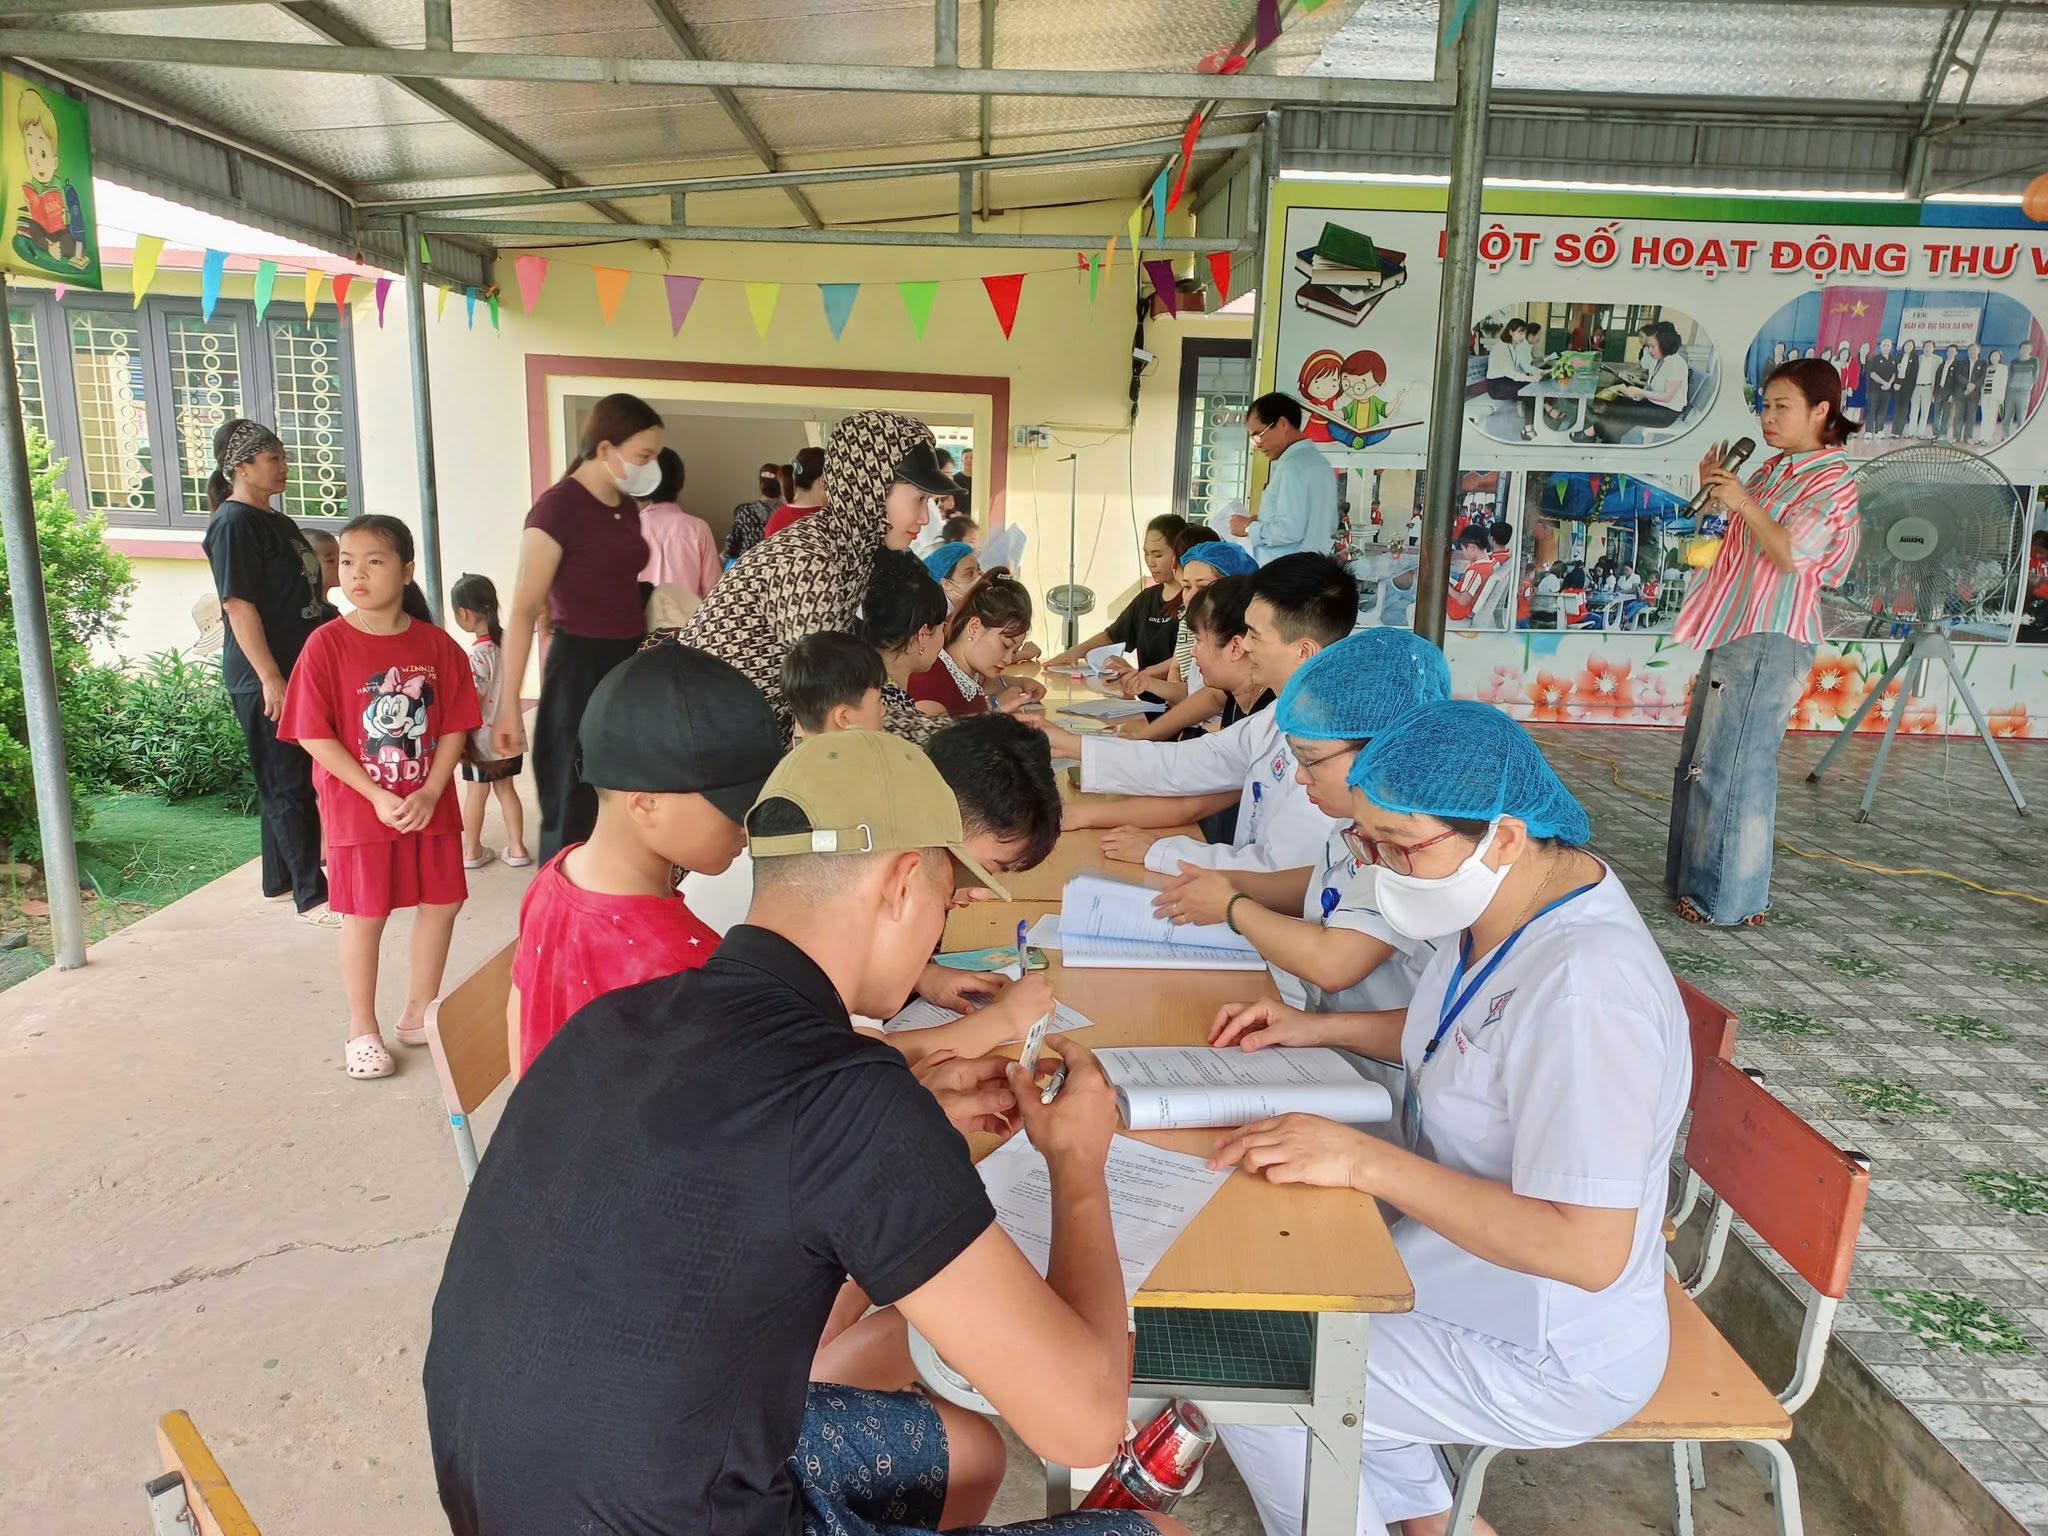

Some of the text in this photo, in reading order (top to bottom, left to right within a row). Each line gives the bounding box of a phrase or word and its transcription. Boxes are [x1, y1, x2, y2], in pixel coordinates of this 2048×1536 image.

[1438, 223, 1541, 269] ỘT
[1555, 222, 1620, 264] SỐ
[1632, 236, 1757, 277] HOẠT
[1770, 234, 1907, 280] ĐỘNG
[1925, 242, 2020, 275] THƯ
[1899, 536, 1924, 545] benny
